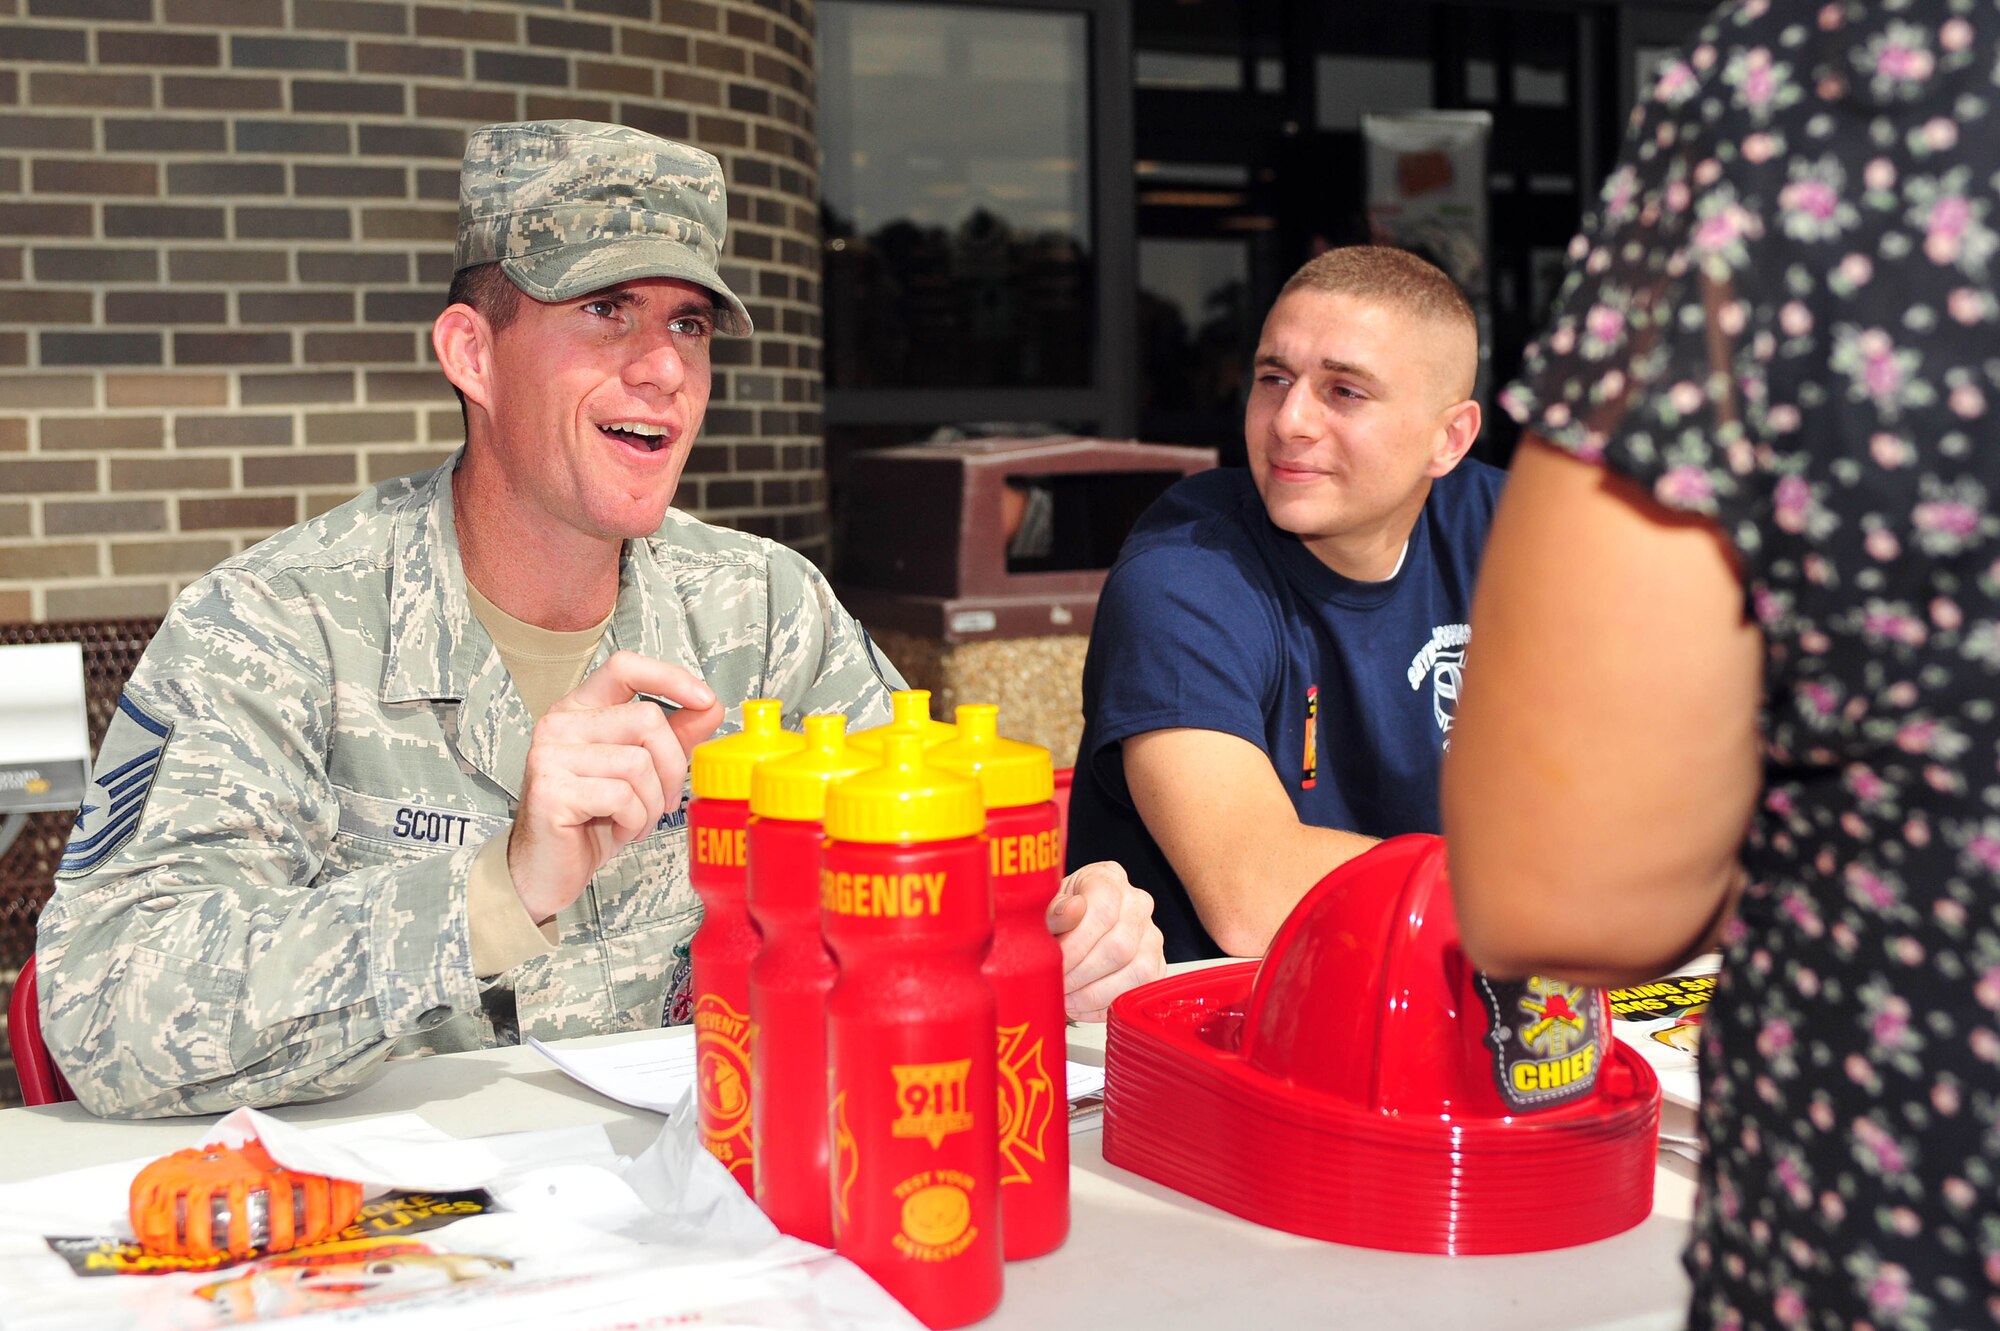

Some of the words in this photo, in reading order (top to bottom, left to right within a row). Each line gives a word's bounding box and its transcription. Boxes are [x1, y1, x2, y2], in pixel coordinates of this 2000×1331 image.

[392, 807, 470, 846] SCOTT
[819, 866, 947, 918] RGENCY
[1513, 1043, 1596, 1092] CHIEF
[903, 1081, 960, 1116] 911
[371, 1201, 485, 1231] LIVES
